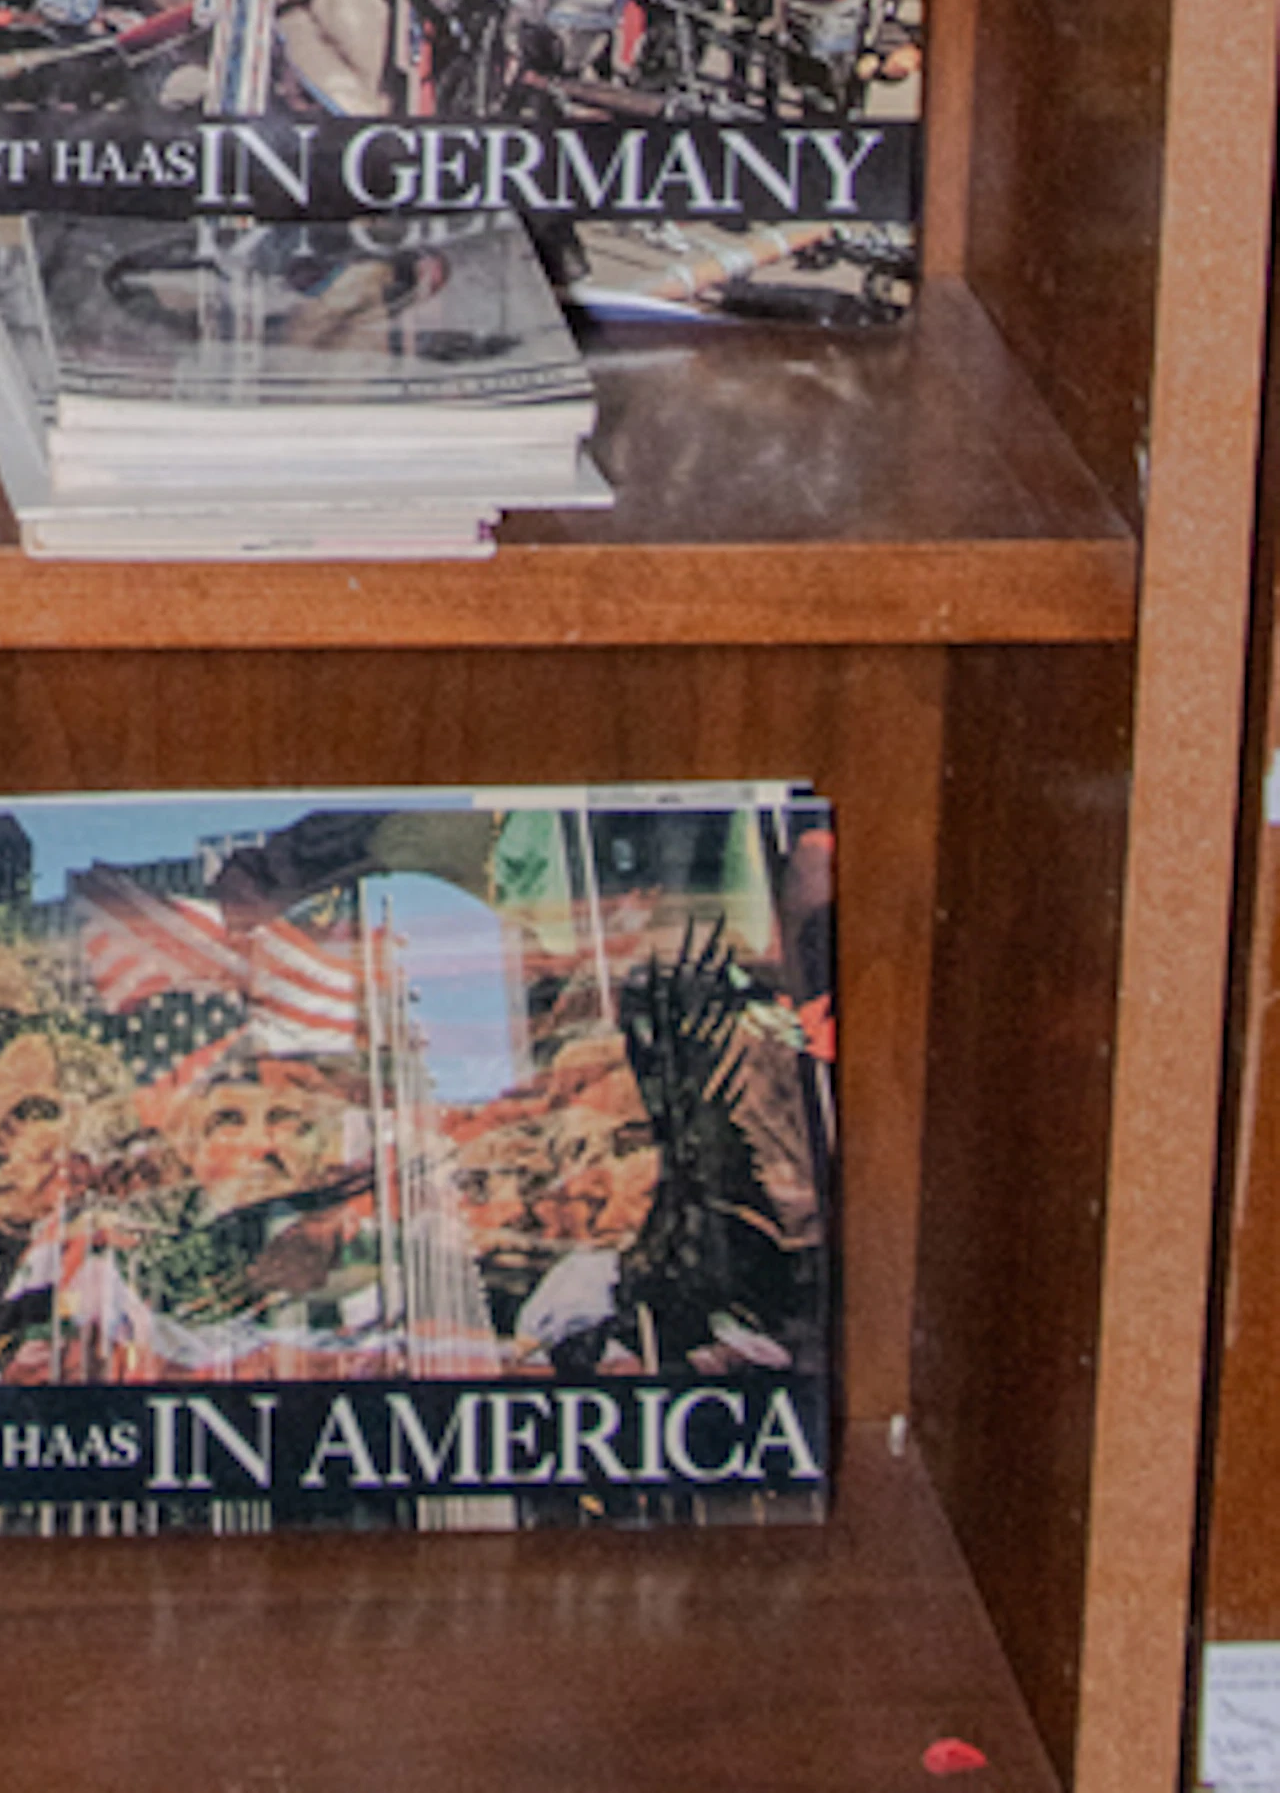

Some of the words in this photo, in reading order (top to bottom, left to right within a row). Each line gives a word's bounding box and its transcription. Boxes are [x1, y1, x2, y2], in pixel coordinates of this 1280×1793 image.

[52, 141, 196, 186] HAAS
[195, 123, 316, 205] IN
[342, 127, 885, 213] GERMANY
[1, 1421, 140, 1468] HAAS
[145, 1393, 281, 1489] IN
[299, 1387, 824, 1490] AMERICA
